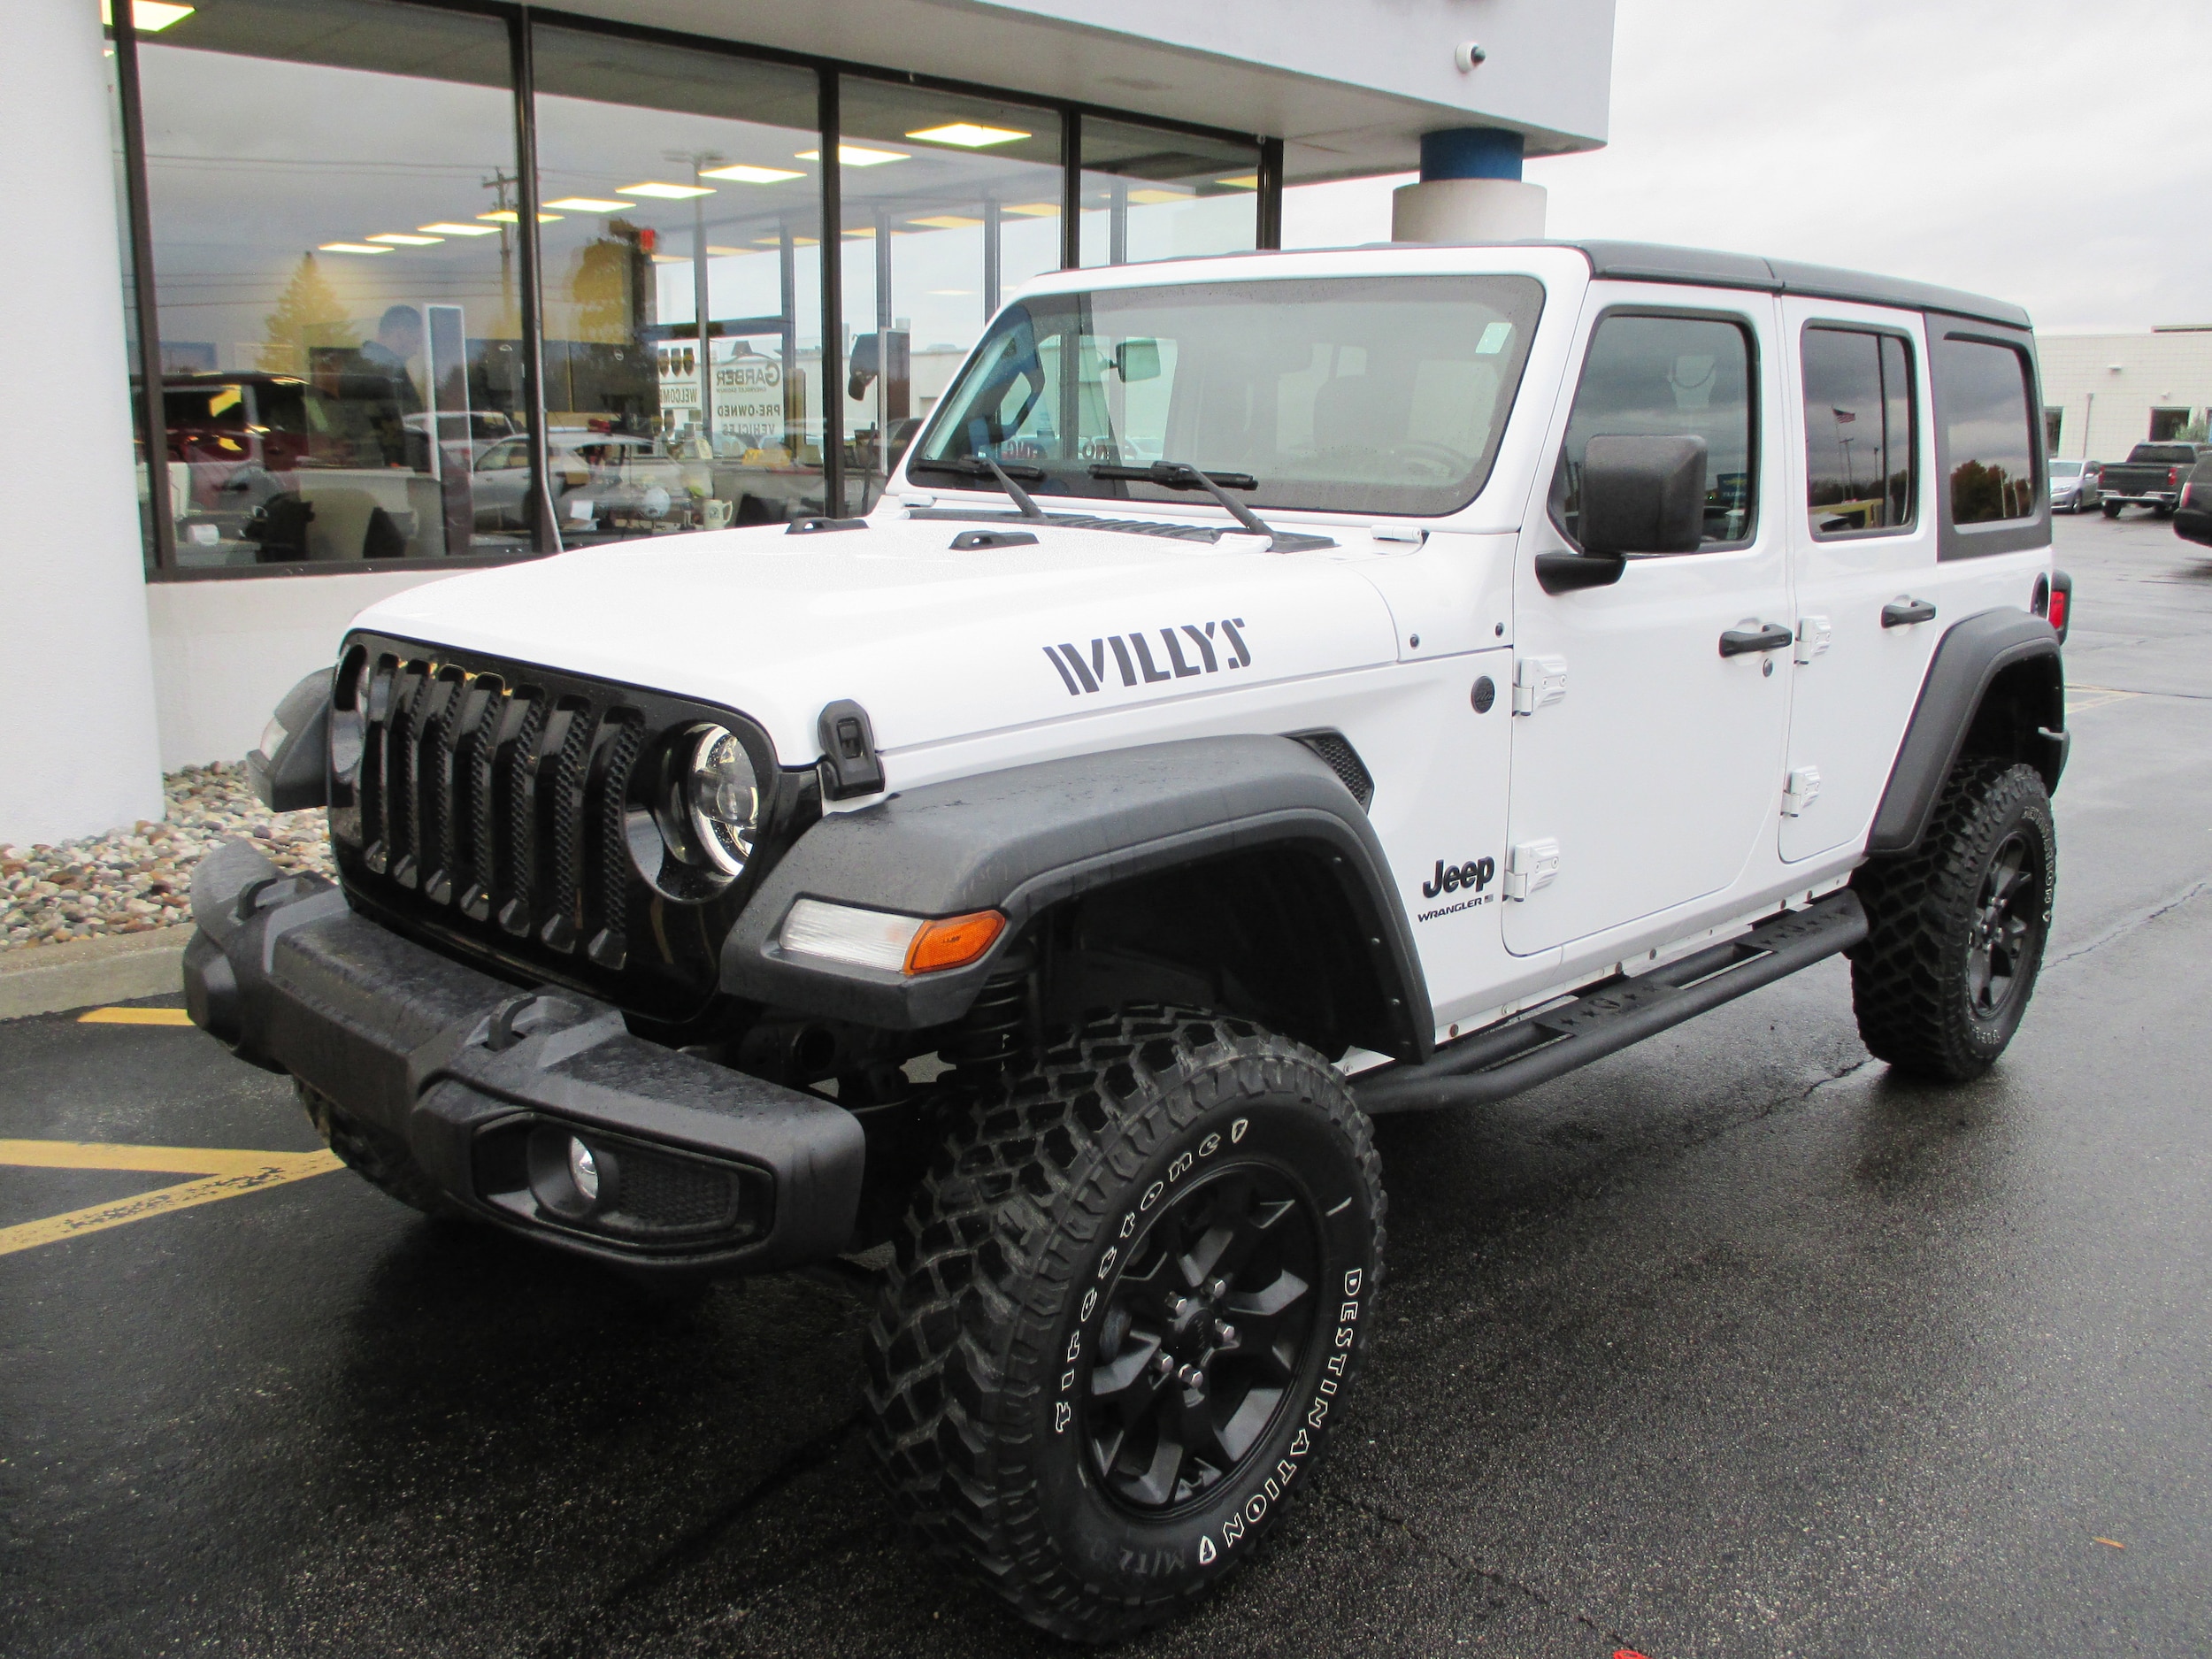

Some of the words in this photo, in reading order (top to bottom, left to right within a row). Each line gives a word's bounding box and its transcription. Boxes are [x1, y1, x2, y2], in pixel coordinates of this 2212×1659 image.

[1042, 618, 1251, 695] WILLYS
[1423, 856, 1495, 898] Jeep
[1417, 897, 1483, 923] WRANGLER
[1221, 1267, 1363, 1548] DESTINATION
